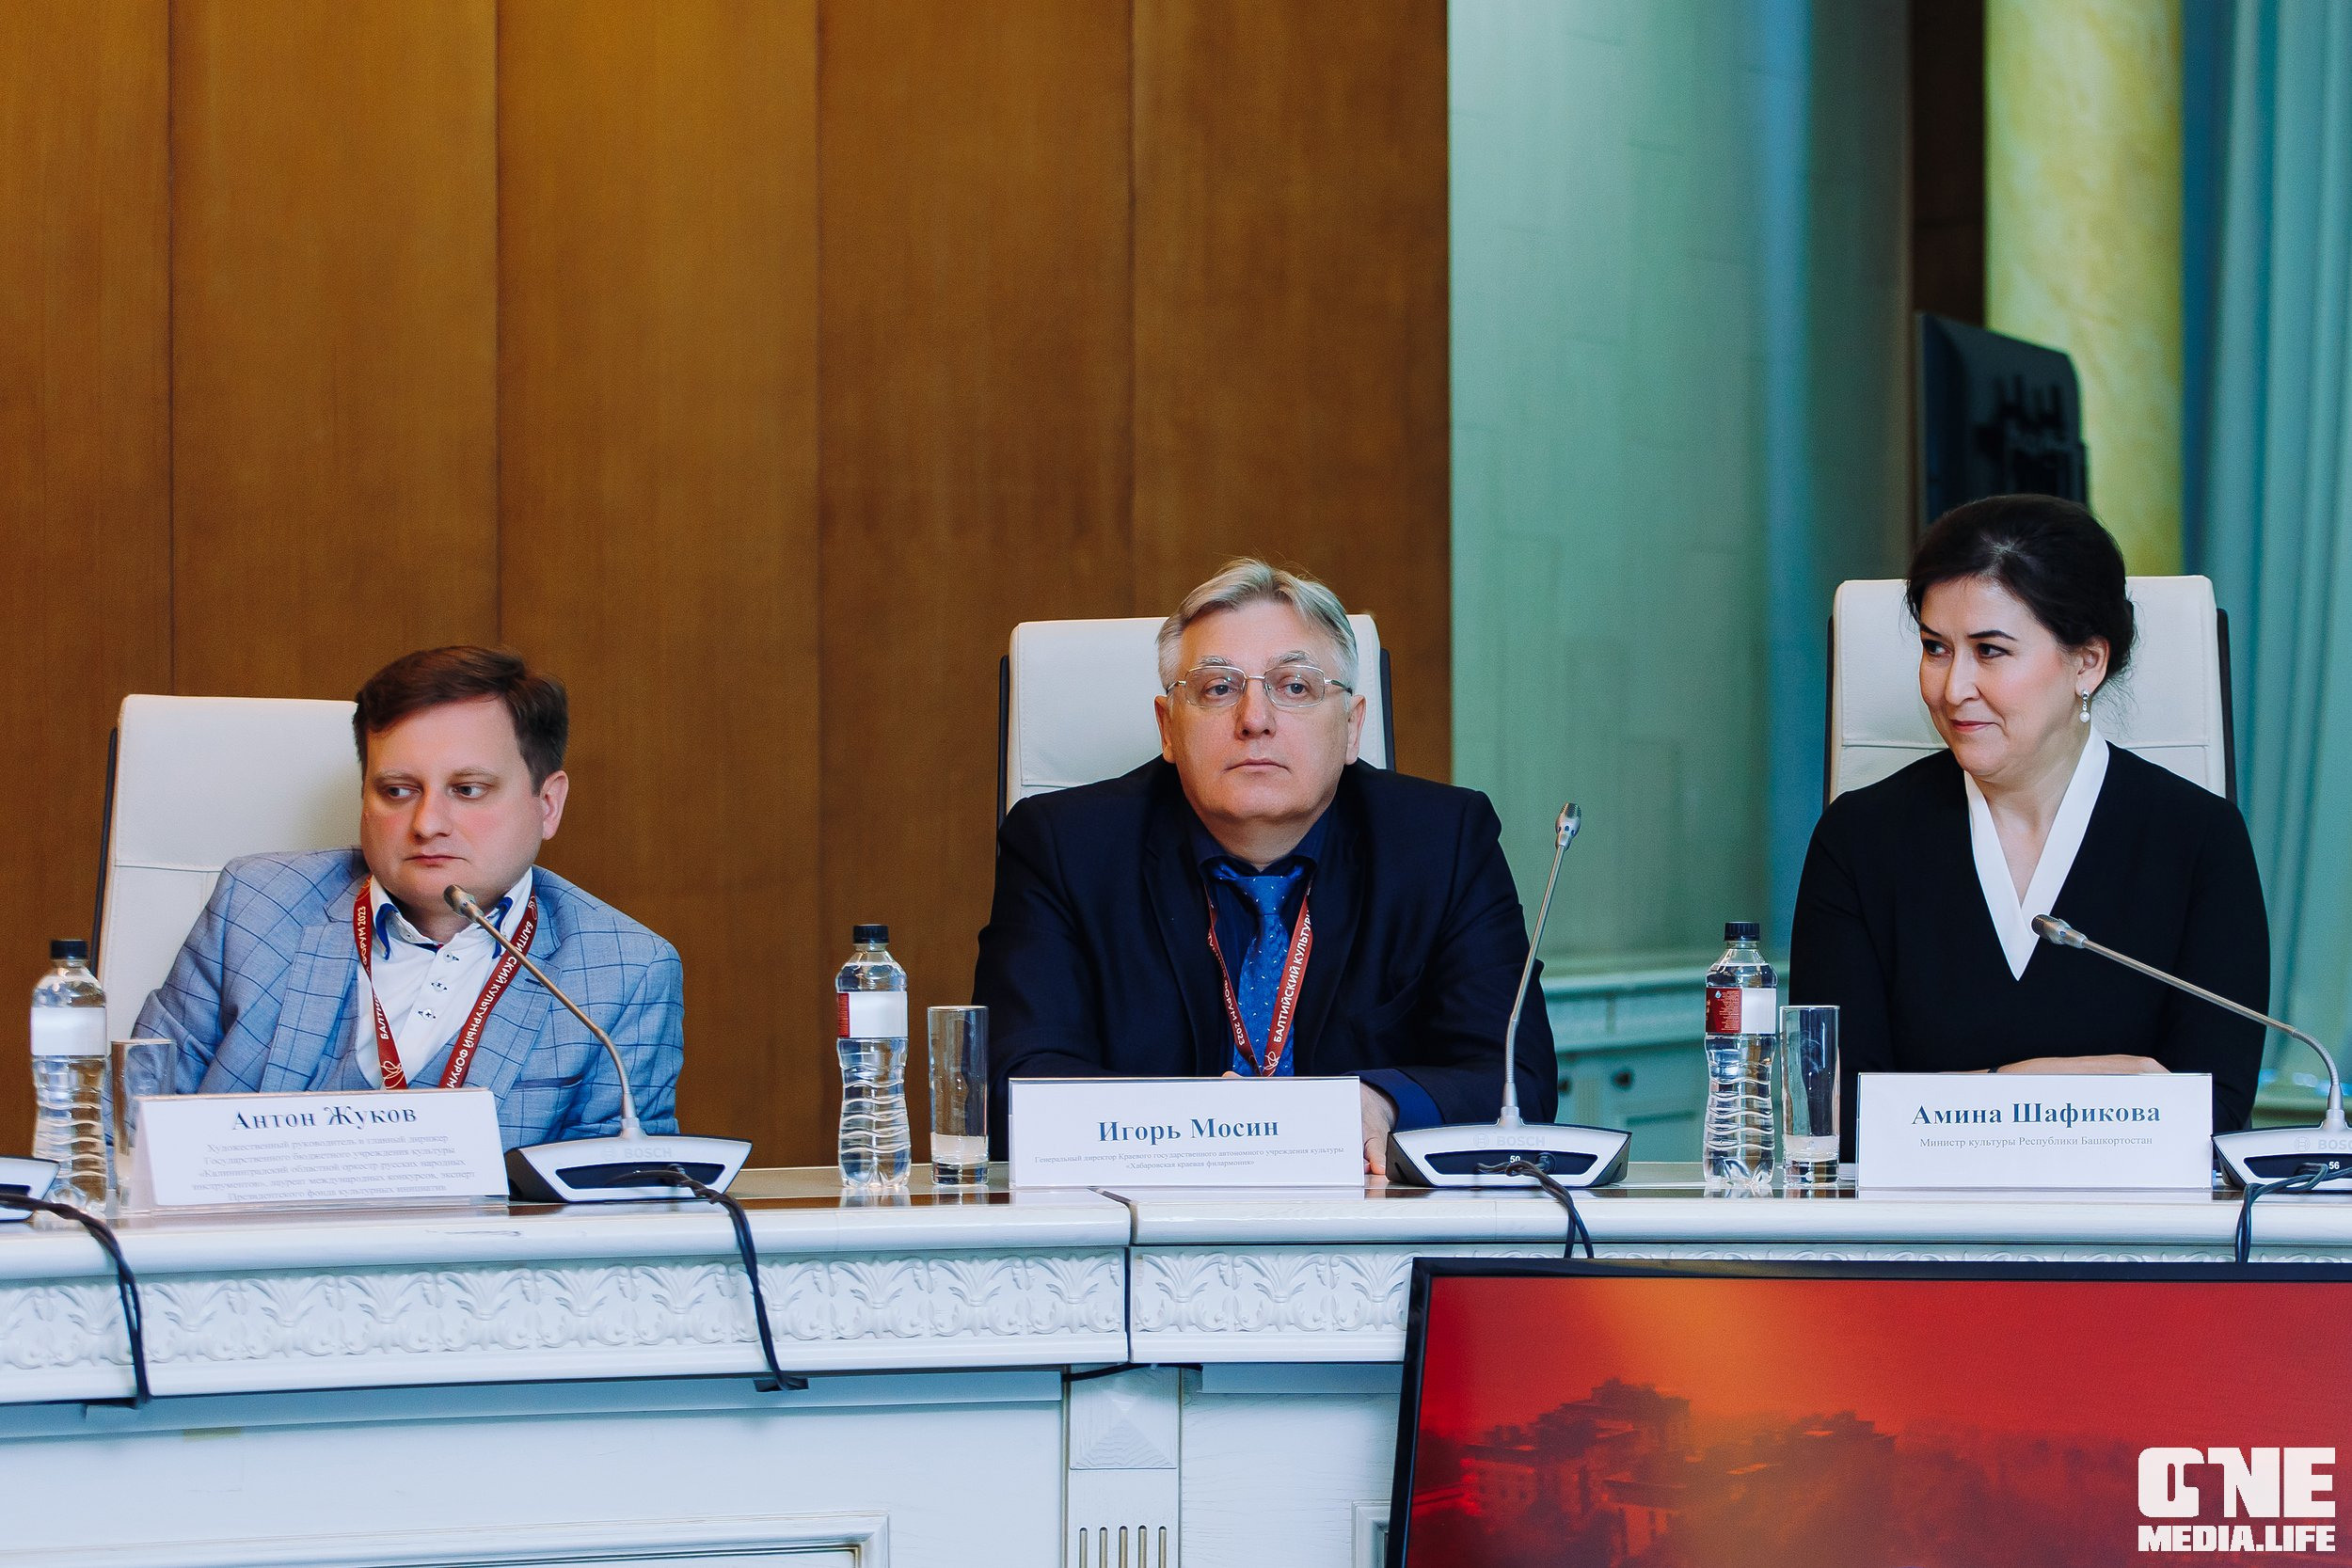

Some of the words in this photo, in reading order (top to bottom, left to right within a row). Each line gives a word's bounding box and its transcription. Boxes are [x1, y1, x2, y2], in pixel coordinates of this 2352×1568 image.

[357, 906, 367, 926] 2023
[496, 919, 533, 989] БАЛТИСКИЙ
[1273, 966, 1301, 1044] БАЛТИЙСКИЙ
[462, 984, 501, 1049] КУЛЬТУРНЫЙ
[1234, 1022, 1246, 1046] 2023
[446, 1048, 469, 1088] ФОРУМ
[231, 1110, 315, 1131] Антон
[323, 1105, 418, 1131] Жуков
[1911, 1104, 2003, 1126] Амина
[2011, 1102, 2161, 1128] Шафикова
[1097, 1119, 1182, 1146] Игорь
[1189, 1117, 1279, 1139] Мосин
[1496, 1135, 1546, 1148] BOSCH
[1919, 1137, 1966, 1148] Министр
[1968, 1137, 2016, 1148] культуры
[2019, 1136, 2079, 1148] Республики
[2081, 1135, 2153, 1147] Башкортостан
[207, 1141, 290, 1154] Художественный
[292, 1138, 358, 1150] руководитель
[366, 1135, 406, 1146] главный
[624, 1147, 673, 1160] BOSCH
[203, 1153, 291, 1166] Государственного
[412, 1147, 455, 1158] культуры
[1034, 1153, 1082, 1164] Генеральный
[1083, 1153, 1118, 1164] директор
[1118, 1151, 1152, 1163] Краевого
[1153, 1149, 1217, 1162] государственного
[1218, 1148, 1264, 1159] автономного
[1264, 1148, 1310, 1158] учреждения
[1311, 1146, 1344, 1156] культуры
[1125, 1162, 1176, 1171] «Хабаровская
[1177, 1161, 1205, 1170] краевая
[1206, 1158, 1255, 1170] филармония»
[2328, 1161, 2340, 1170] 56
